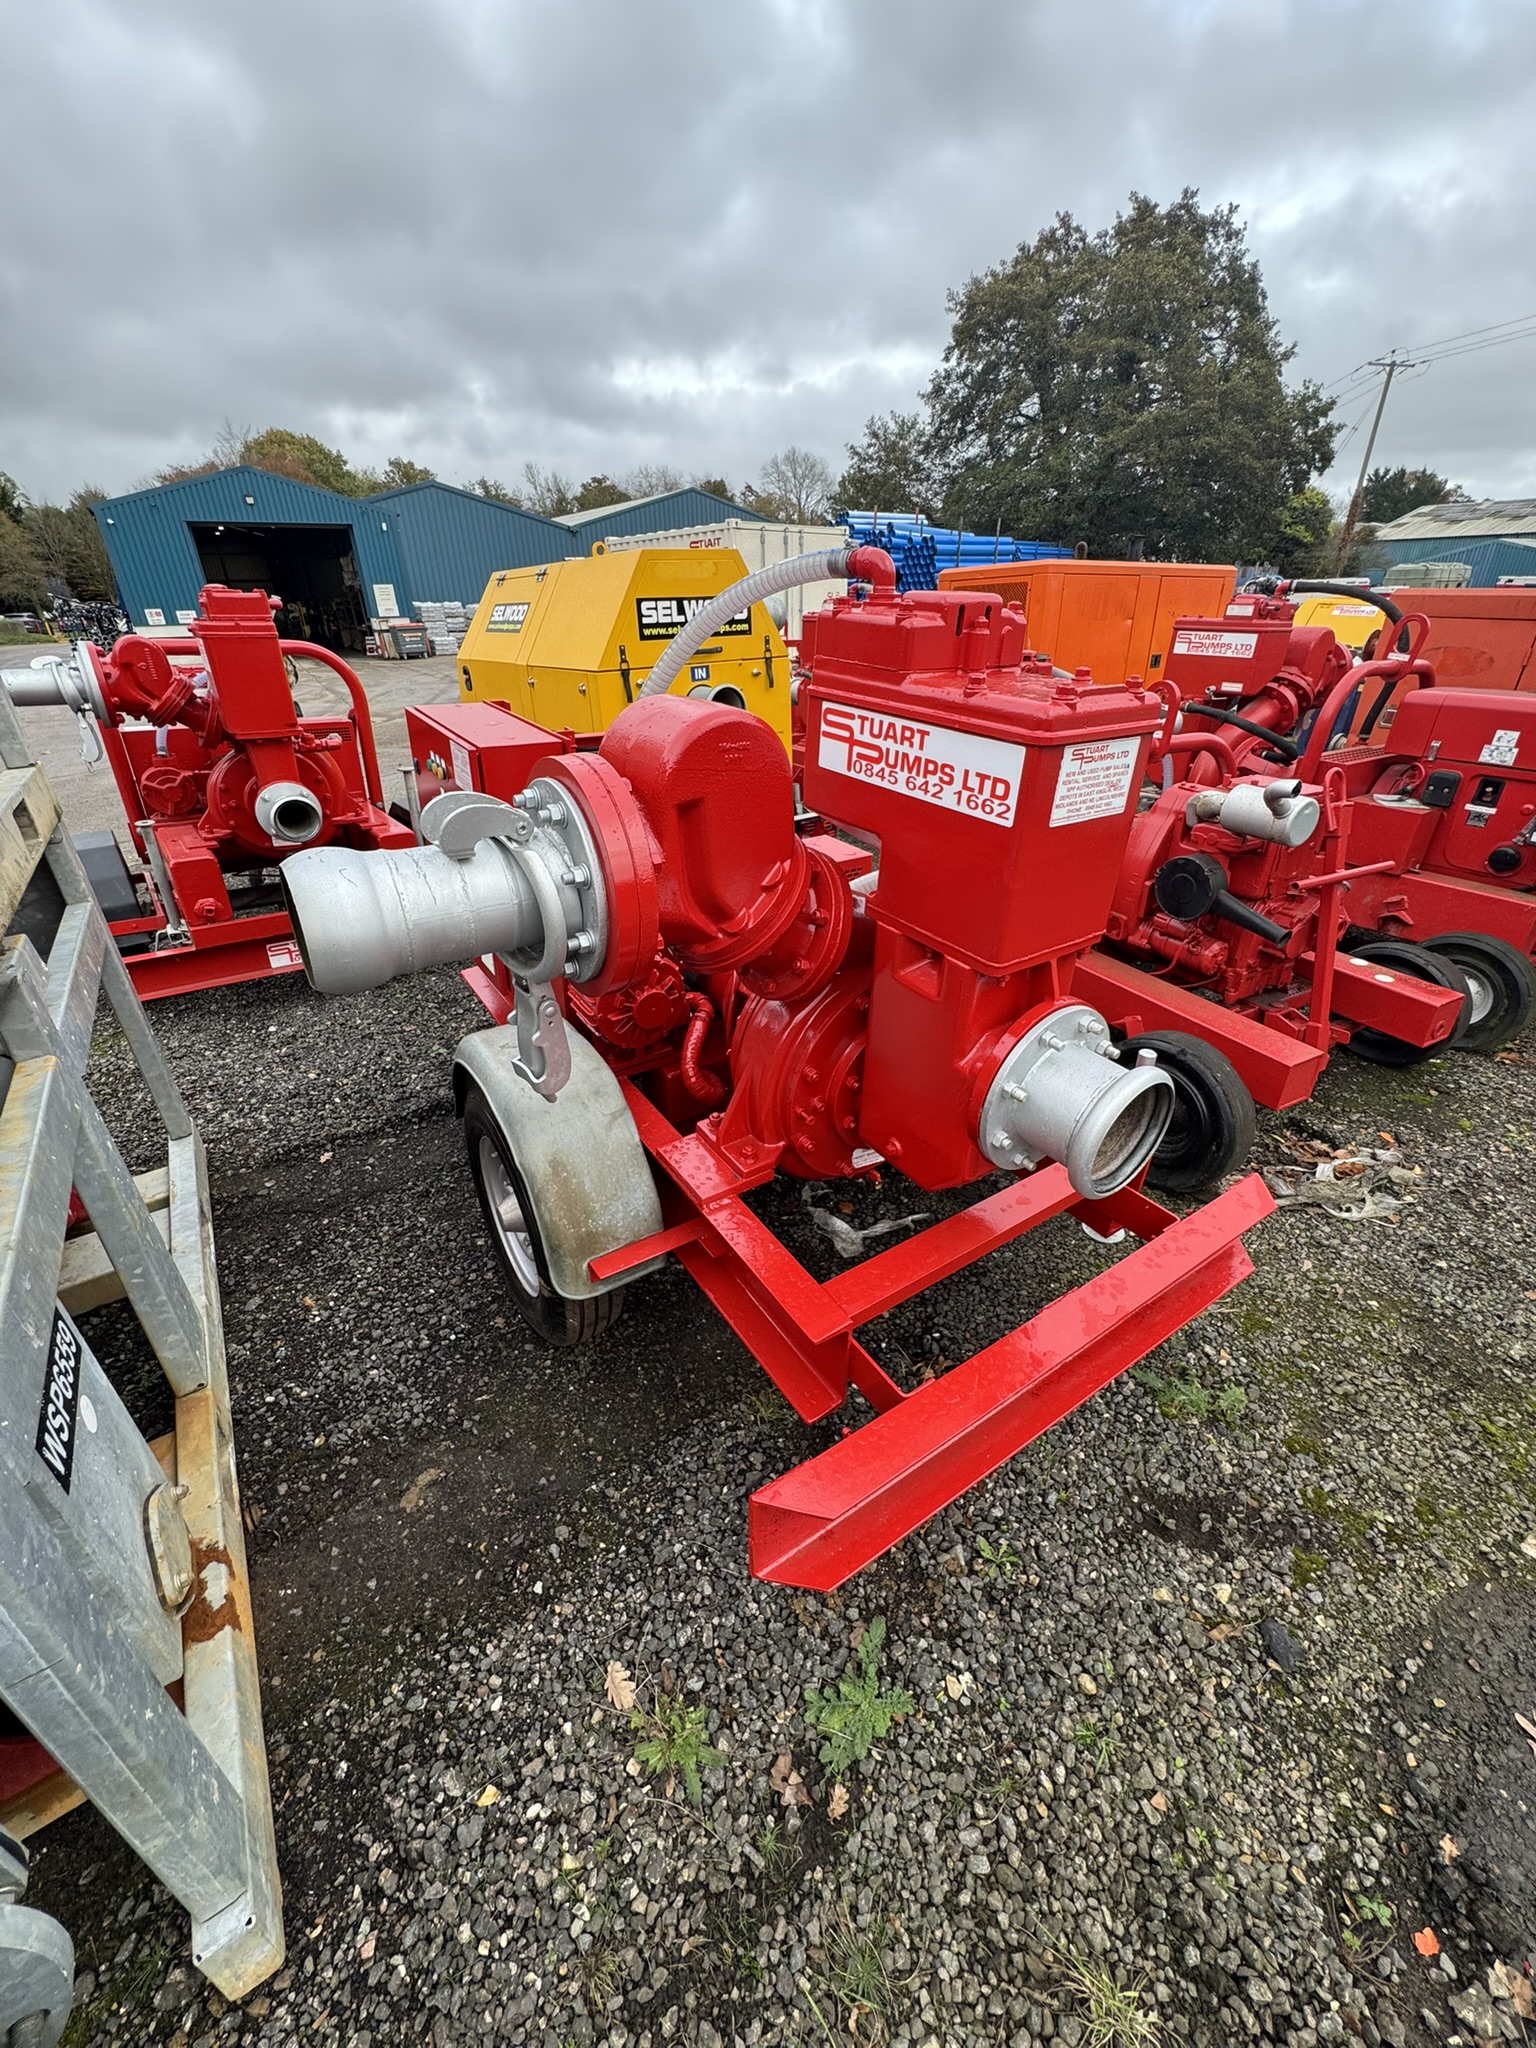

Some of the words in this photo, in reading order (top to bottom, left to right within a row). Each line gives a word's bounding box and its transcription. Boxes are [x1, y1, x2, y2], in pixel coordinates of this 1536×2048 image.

[490, 604, 529, 621] SELWOOD
[1177, 633, 1224, 643] STUART
[1187, 641, 1233, 652] PUMPS
[1234, 643, 1253, 652] LTD
[694, 667, 707, 680] IN
[822, 706, 931, 751] STUART
[1071, 744, 1110, 761] STUART
[1079, 752, 1116, 770] PUMPS
[1116, 750, 1130, 760] LTD
[846, 738, 956, 786] PUMPS
[961, 768, 1011, 802] LTD
[853, 759, 899, 785] 0845
[905, 776, 945, 800] 642
[953, 790, 1012, 821] 1662
[42, 1319, 77, 1476] WSP6559
